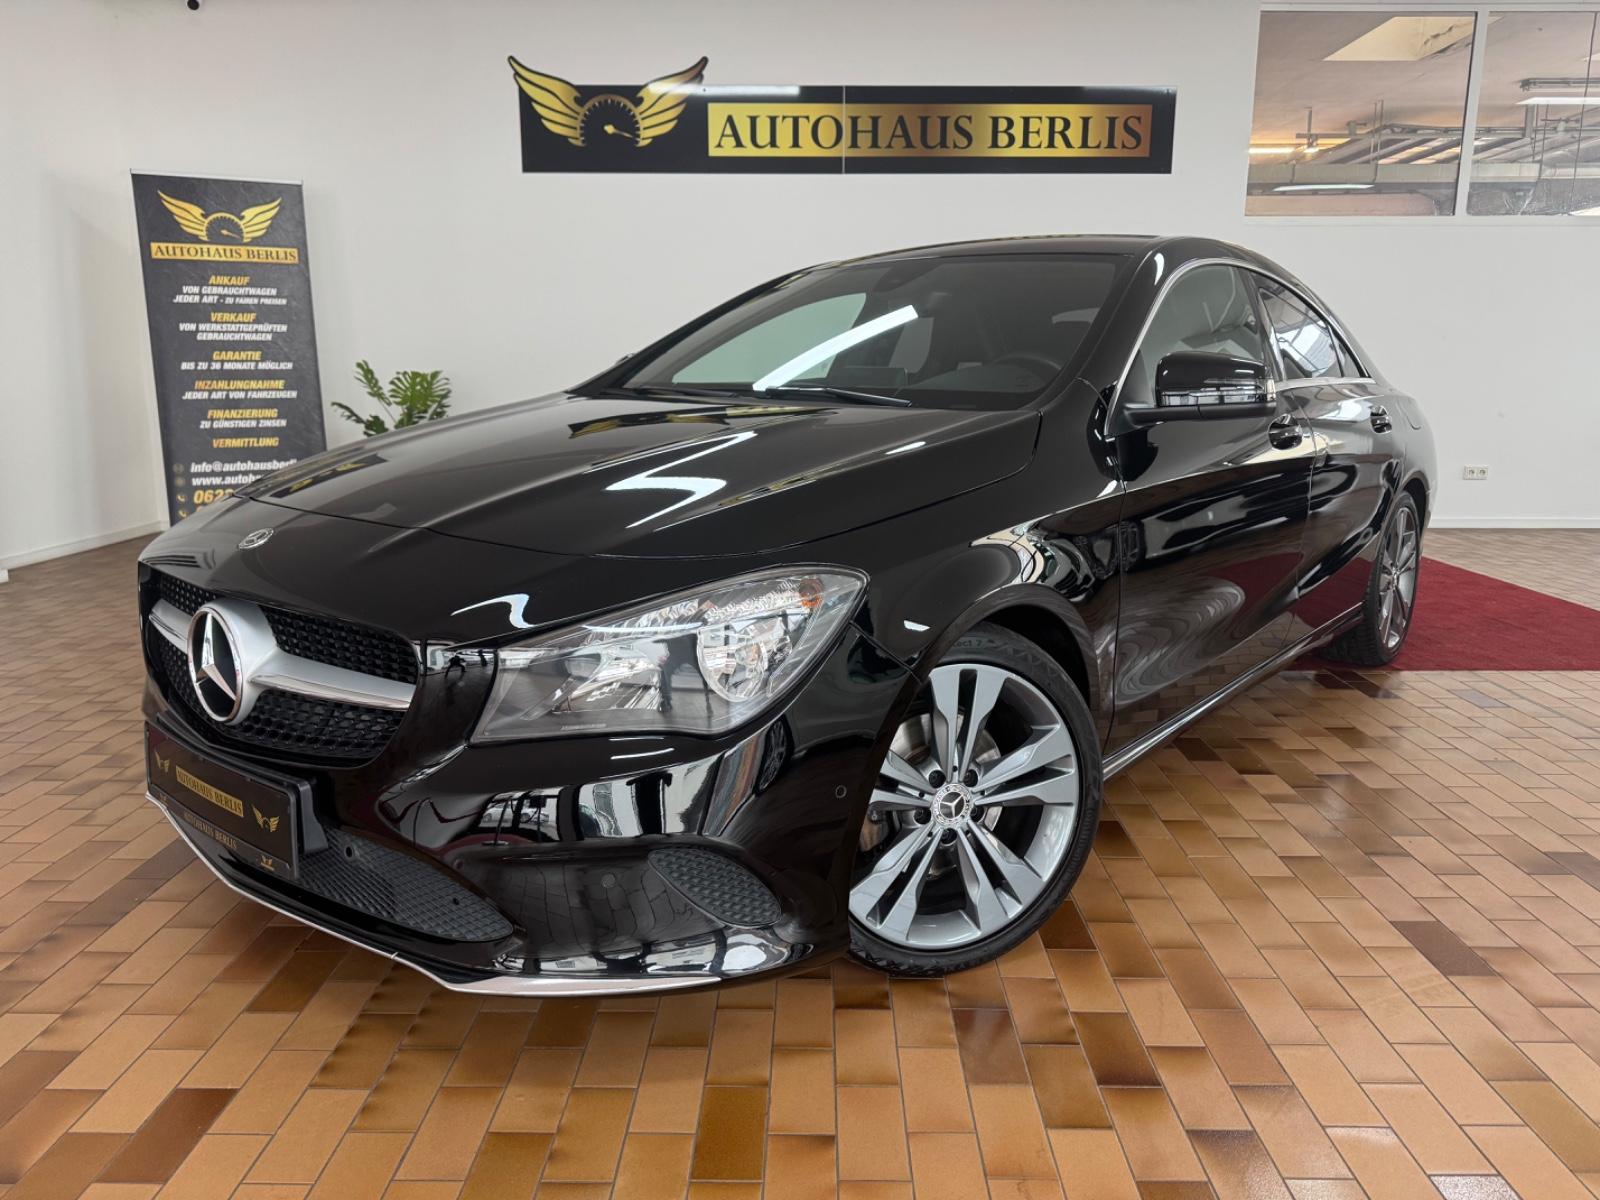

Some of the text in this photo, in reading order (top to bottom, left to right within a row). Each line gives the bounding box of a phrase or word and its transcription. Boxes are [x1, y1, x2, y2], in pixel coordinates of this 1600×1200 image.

[715, 114, 1142, 150] AUTOHAUS BERLIS
[154, 245, 296, 261] AUTOHAUS BERLIS
[209, 275, 250, 286] ANKAUF
[182, 286, 277, 296] VON GEBRAUCHTWAGEN
[173, 295, 198, 303] JEDER
[201, 296, 218, 304] ART
[260, 298, 287, 306] PREISEN
[211, 312, 257, 323] VERKAUF
[179, 322, 287, 333] VON WERKSTATTGEPRÜFTEN
[197, 333, 272, 341] GEBRAUCHTWAGEN
[213, 351, 262, 361] GARANTIE
[181, 360, 293, 370] BIS ZU 36 MONATE MÖGLICH
[195, 380, 285, 390] INZAHLUNGNAHME
[182, 390, 297, 400] JEDER ART VON FAHRZEUGEN
[207, 408, 278, 419] FINANZIERUNG
[200, 419, 287, 429] ZU GÜNSTIGEN ZINSEN
[212, 437, 279, 448] VERMITTLUNG
[177, 768, 242, 814] AUTOHAUS BERLIS
[215, 829, 238, 850] BERLIS
